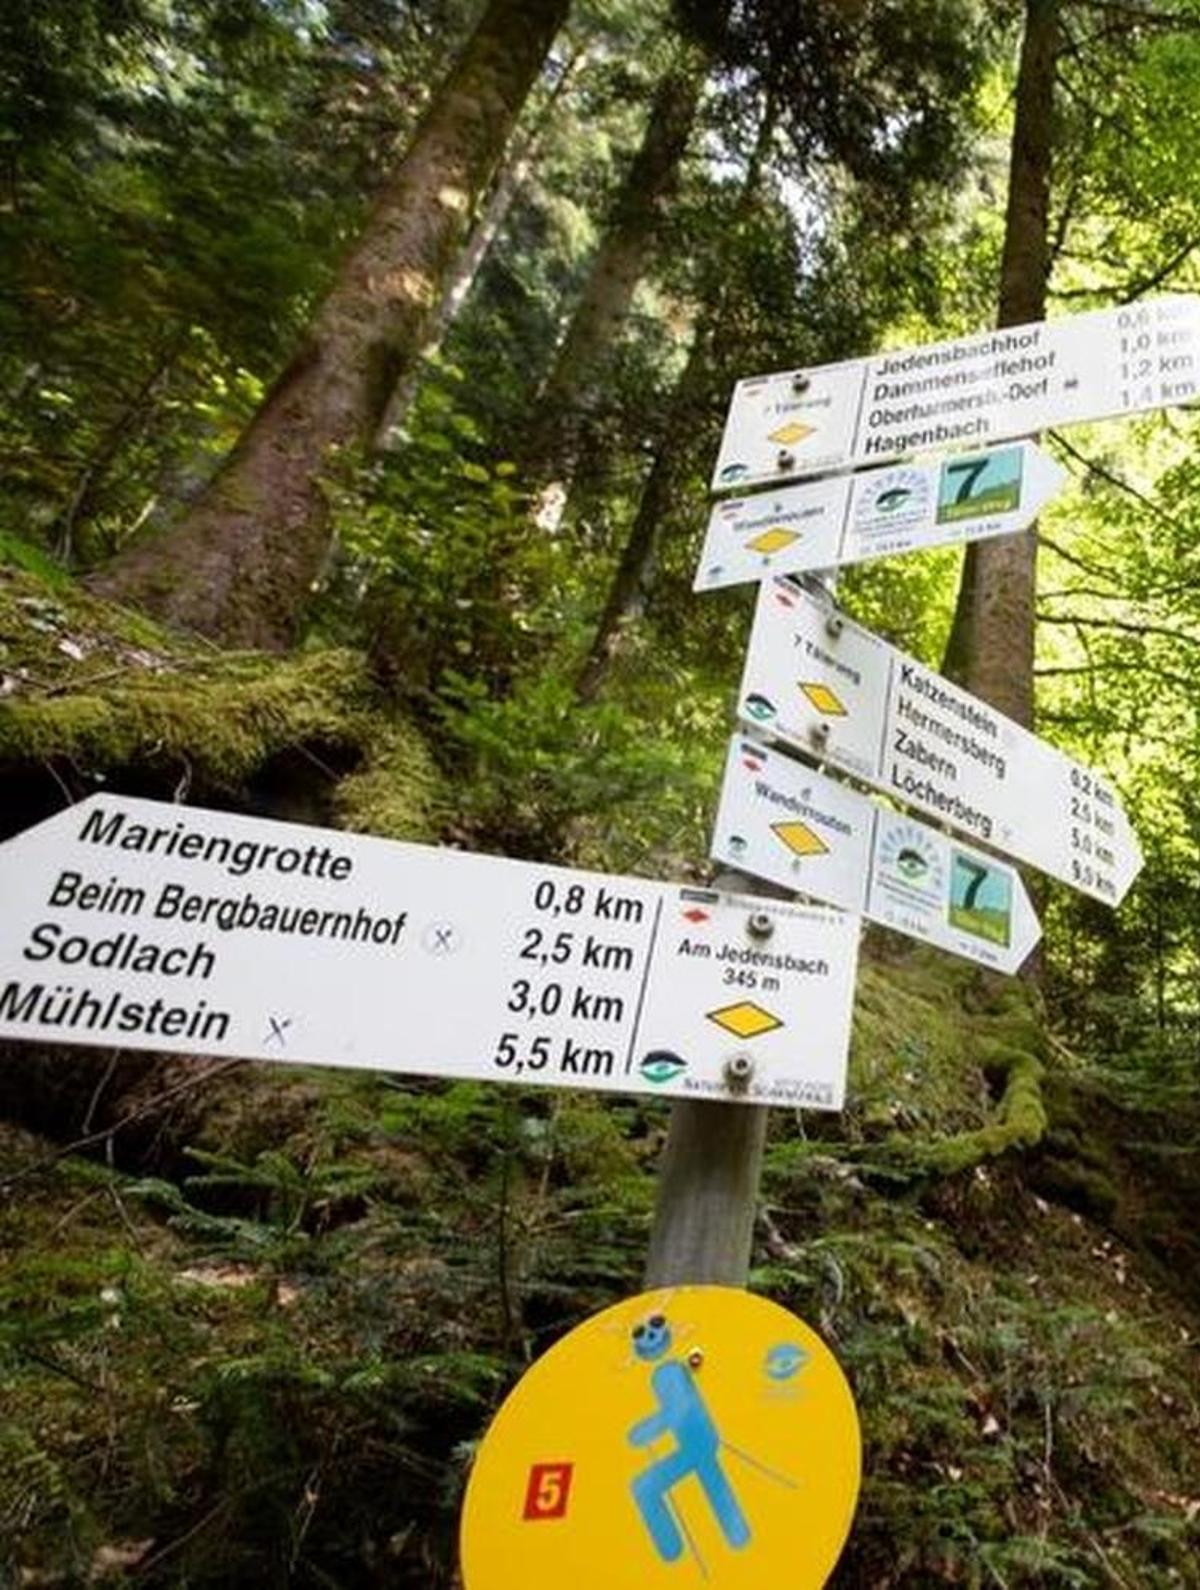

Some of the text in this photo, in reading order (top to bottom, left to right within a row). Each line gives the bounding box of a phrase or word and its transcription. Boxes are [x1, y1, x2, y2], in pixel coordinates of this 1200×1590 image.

[877, 328, 1041, 377] Jedensbachhof
[1121, 333, 1151, 354] 1,0
[1122, 354, 1194, 380] 1,2 km
[1161, 380, 1196, 398] km
[864, 416, 990, 455] Hagenbach
[947, 457, 989, 506] 7
[900, 664, 998, 738] Katzenstein
[893, 728, 958, 781] Zabern
[898, 696, 1007, 780] Hermersberg
[892, 763, 993, 839] Löcherberg
[78, 808, 354, 882] Mariengrotte
[534, 880, 644, 923] 0,8 km
[957, 854, 988, 910] 7
[48, 871, 407, 945] Beim Bergbauernhof
[23, 922, 216, 980] Sodlach
[520, 928, 634, 971] 2,5 km
[678, 937, 829, 976] Am Jedensbach
[507, 979, 624, 1023] 3,0 km
[722, 967, 780, 992] 345 m
[0, 981, 231, 1041] Mühlstein
[495, 1032, 614, 1076] 5,5 km
[536, 1470, 561, 1511] 5
